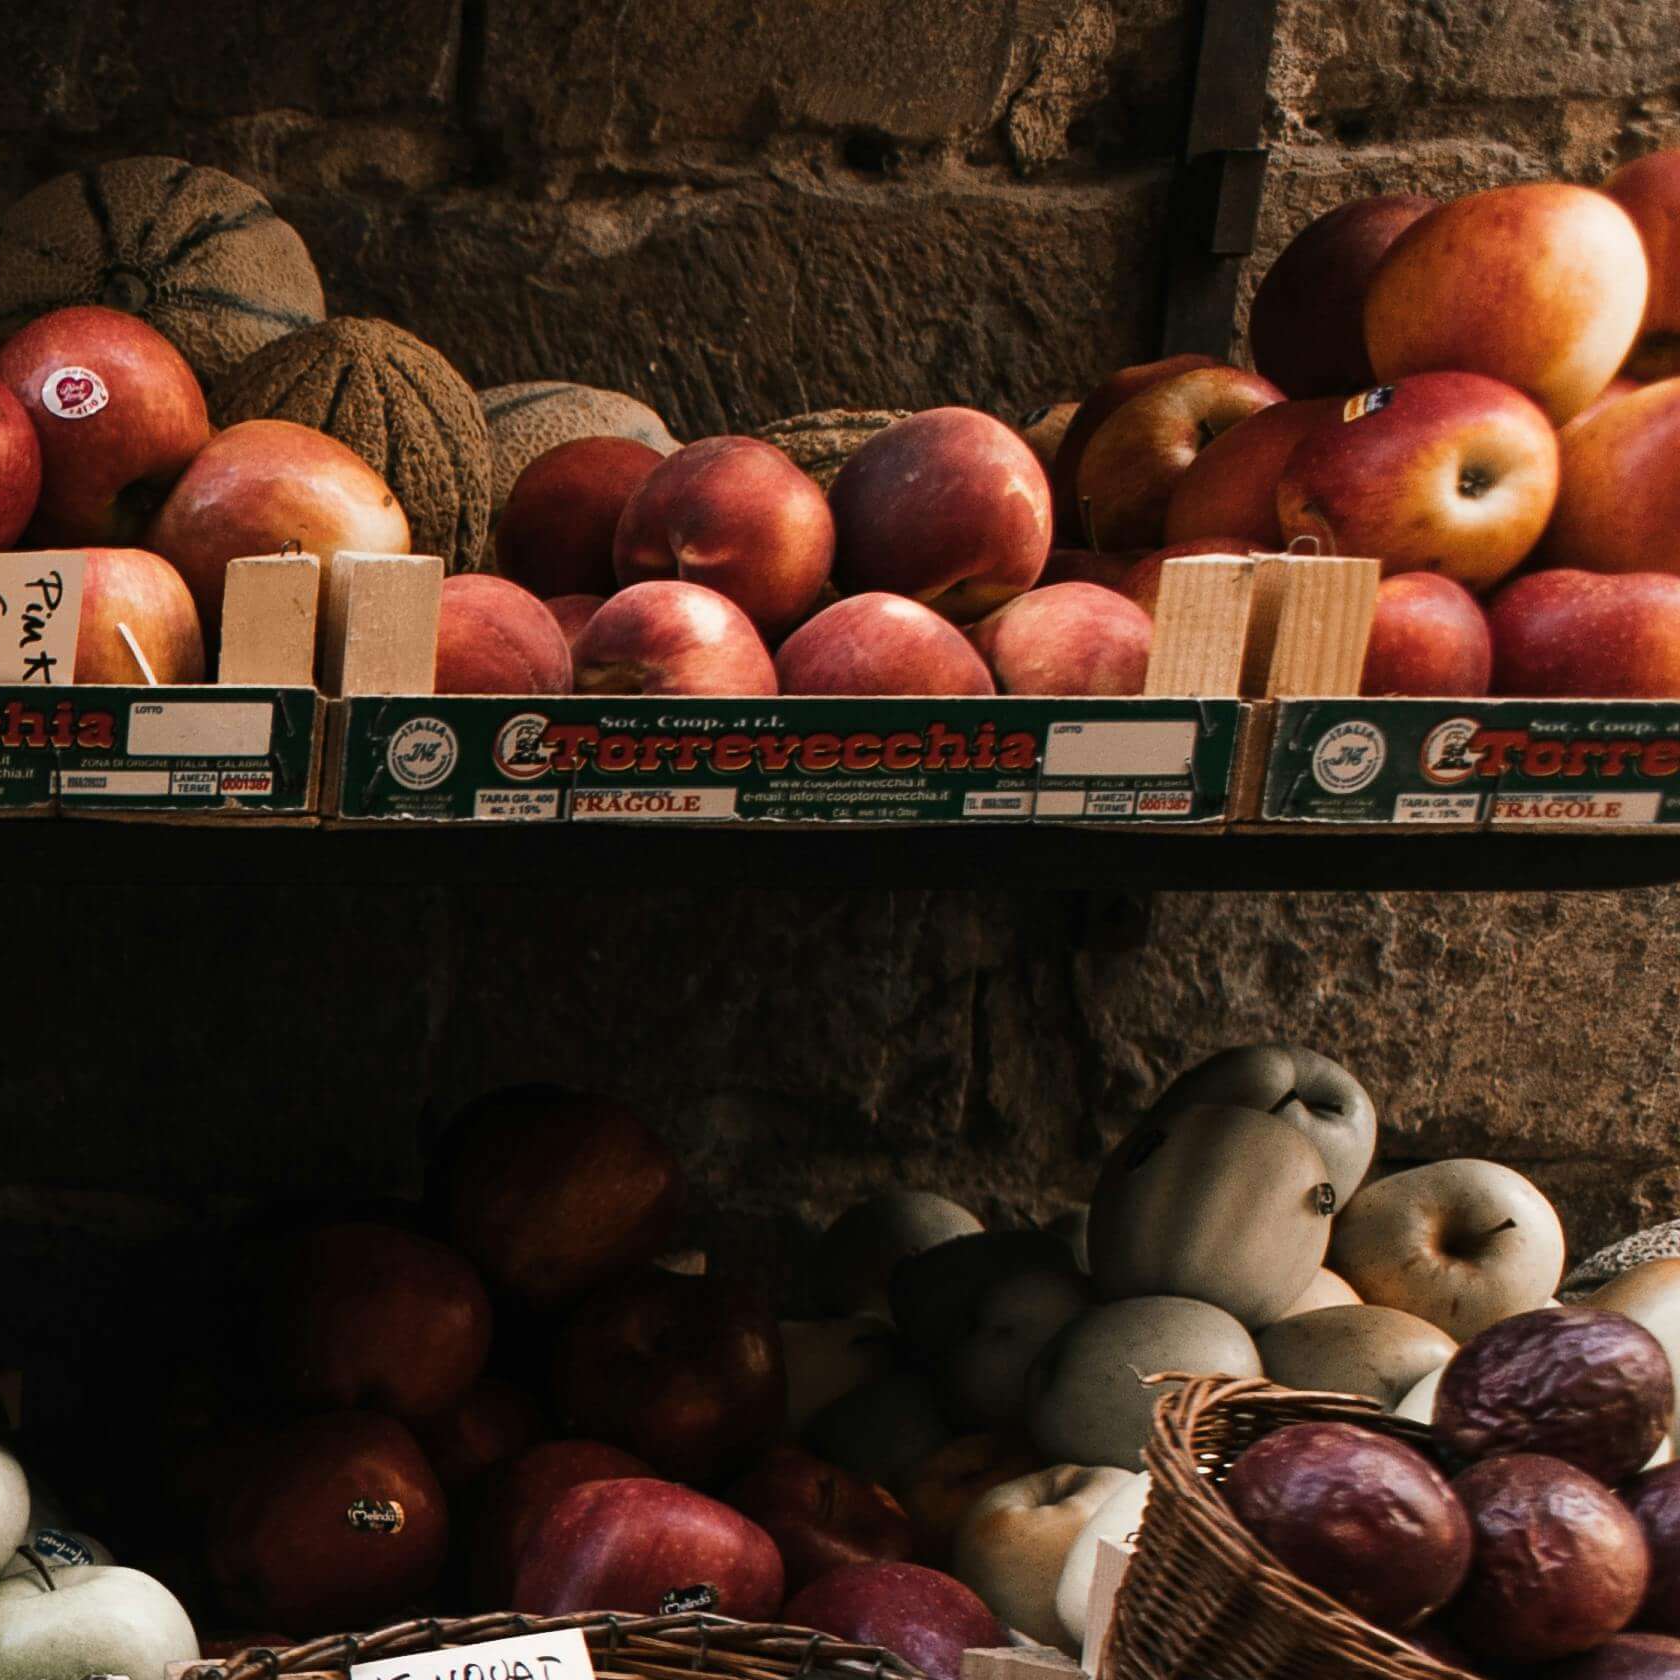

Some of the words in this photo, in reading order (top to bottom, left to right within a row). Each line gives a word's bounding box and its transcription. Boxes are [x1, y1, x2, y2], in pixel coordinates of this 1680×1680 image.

[135, 705, 163, 714] LOTTO
[541, 722, 1036, 774] Torrevecchia
[176, 783, 212, 793] TERME
[573, 795, 701, 812] FRAGOLE
[1491, 801, 1622, 818] FRAGOLE
